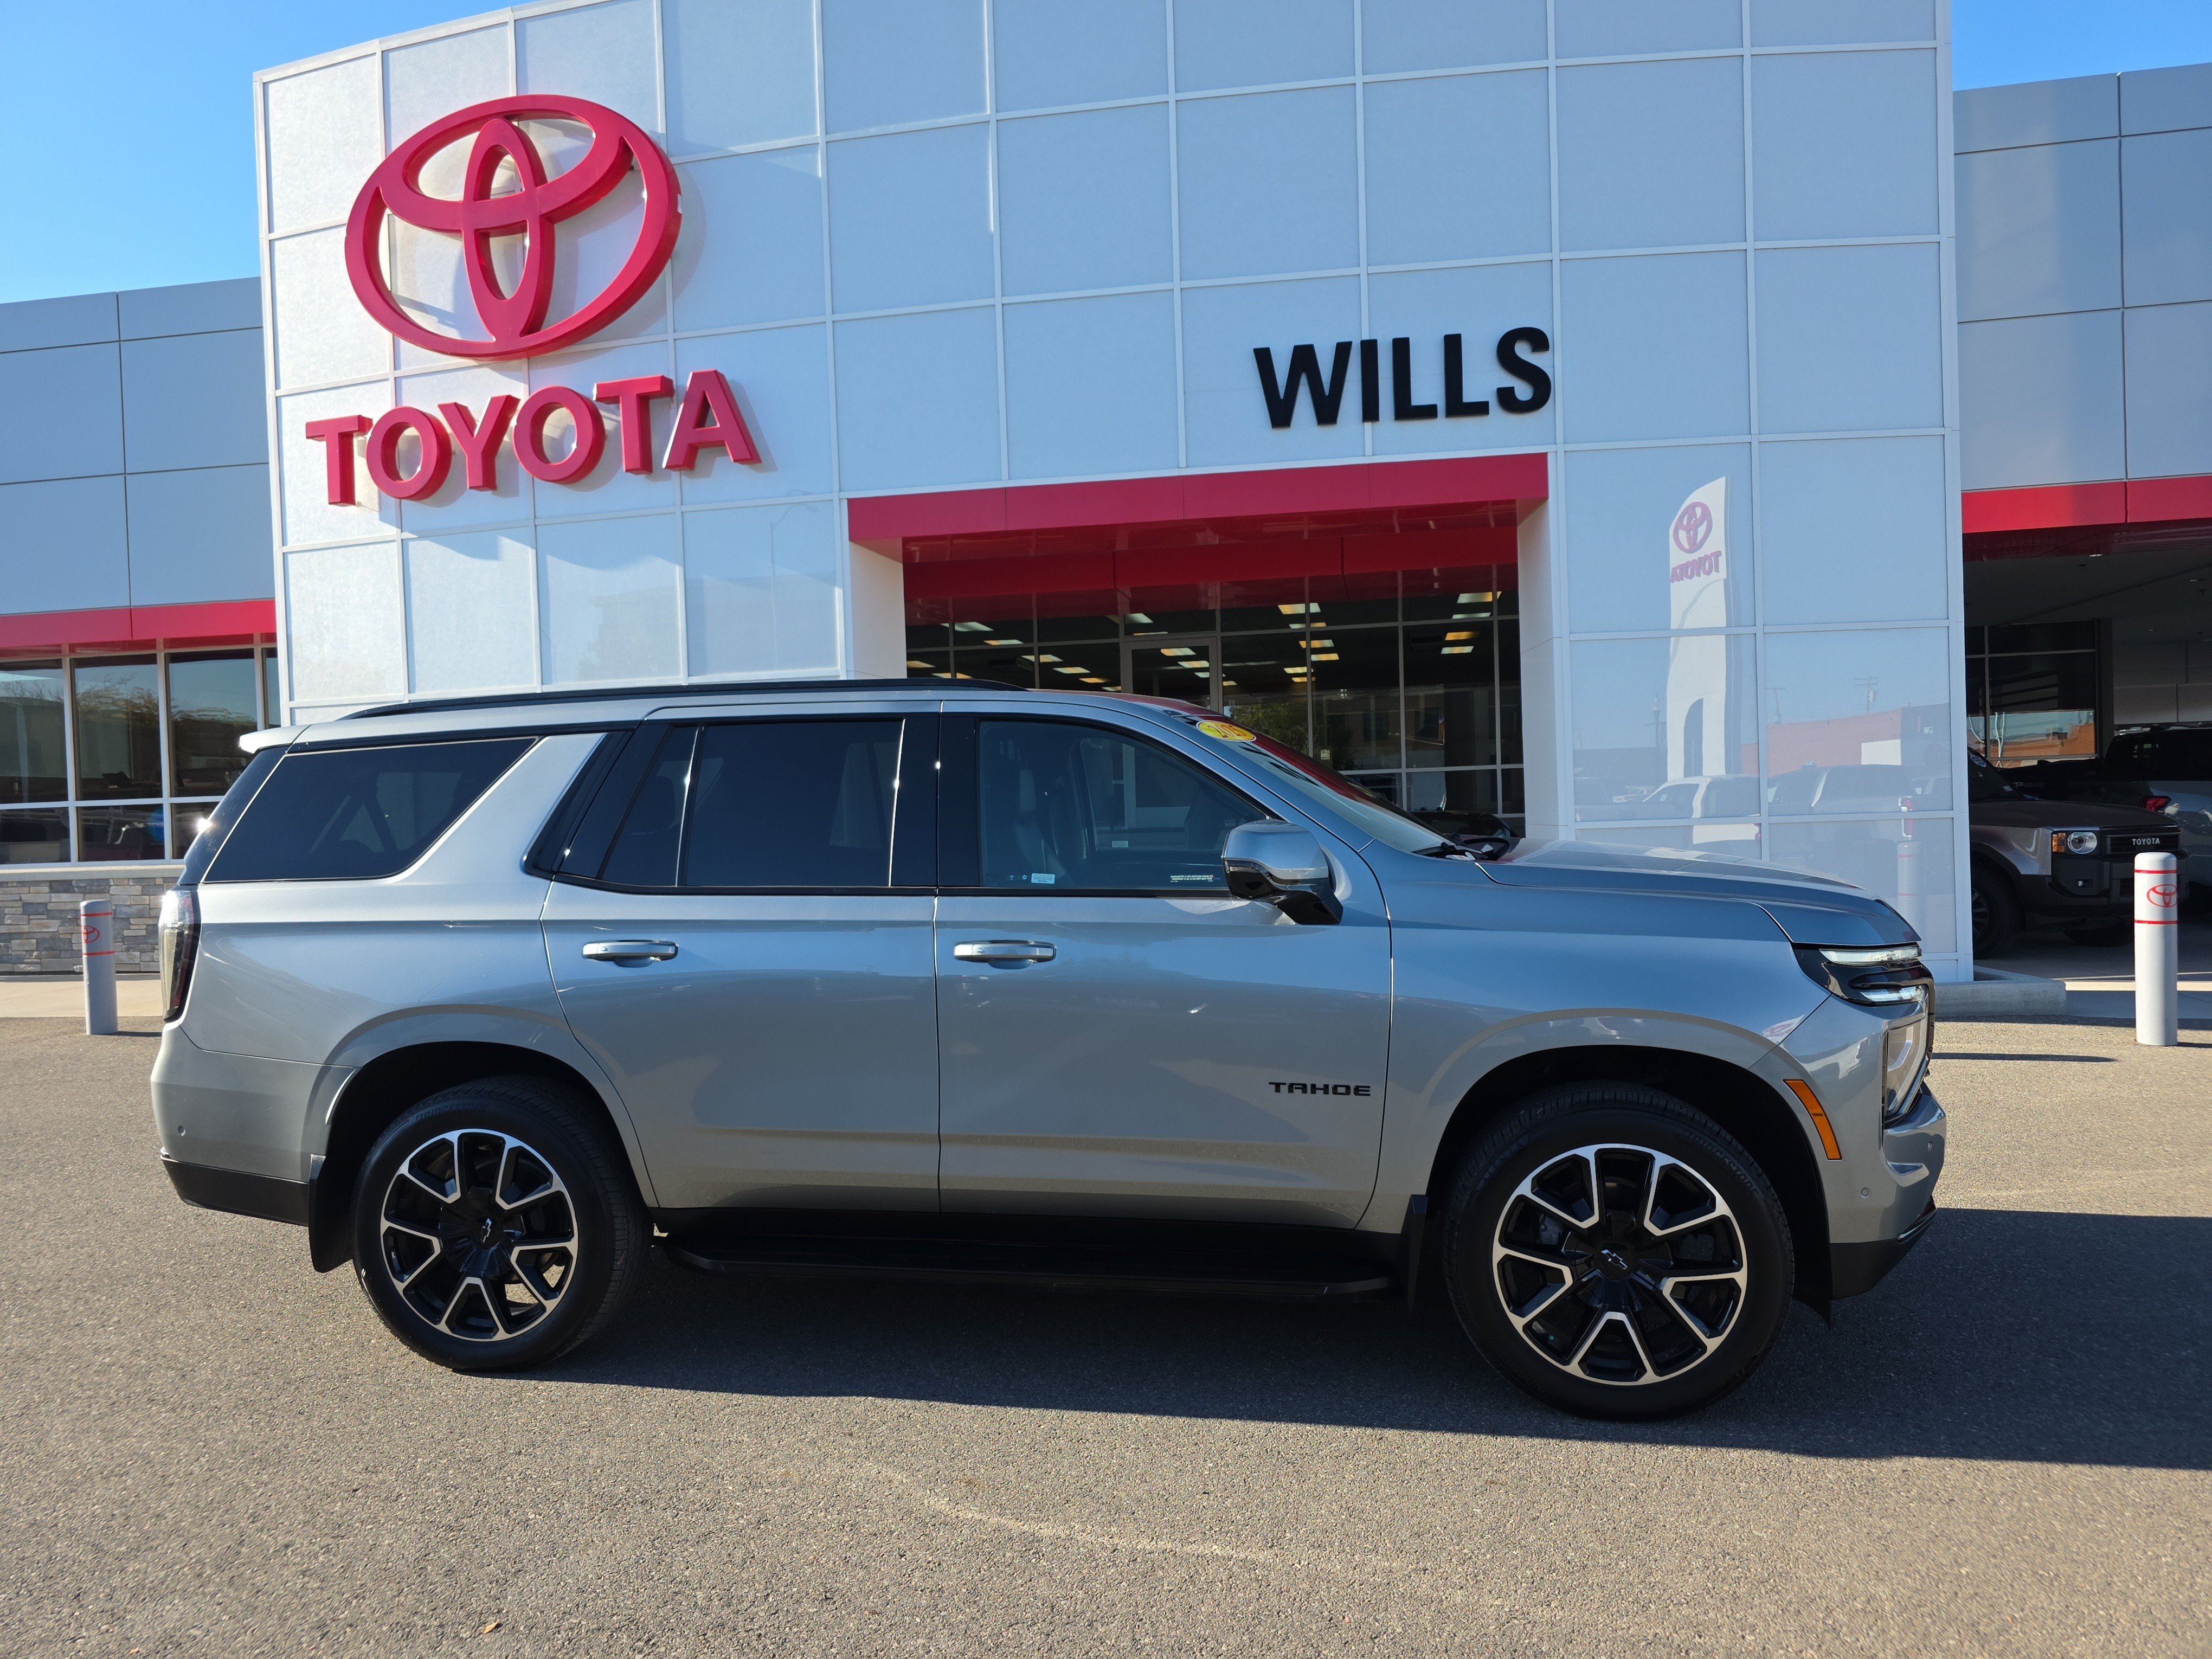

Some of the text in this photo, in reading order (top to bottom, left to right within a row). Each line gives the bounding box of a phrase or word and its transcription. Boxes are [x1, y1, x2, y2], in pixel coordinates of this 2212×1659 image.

[1253, 327, 1551, 428] WILLS
[305, 370, 762, 507] TOYOTA
[1269, 1082, 1371, 1096] TAHOE
[1680, 1127, 1759, 1196] BRIDGESTONE
